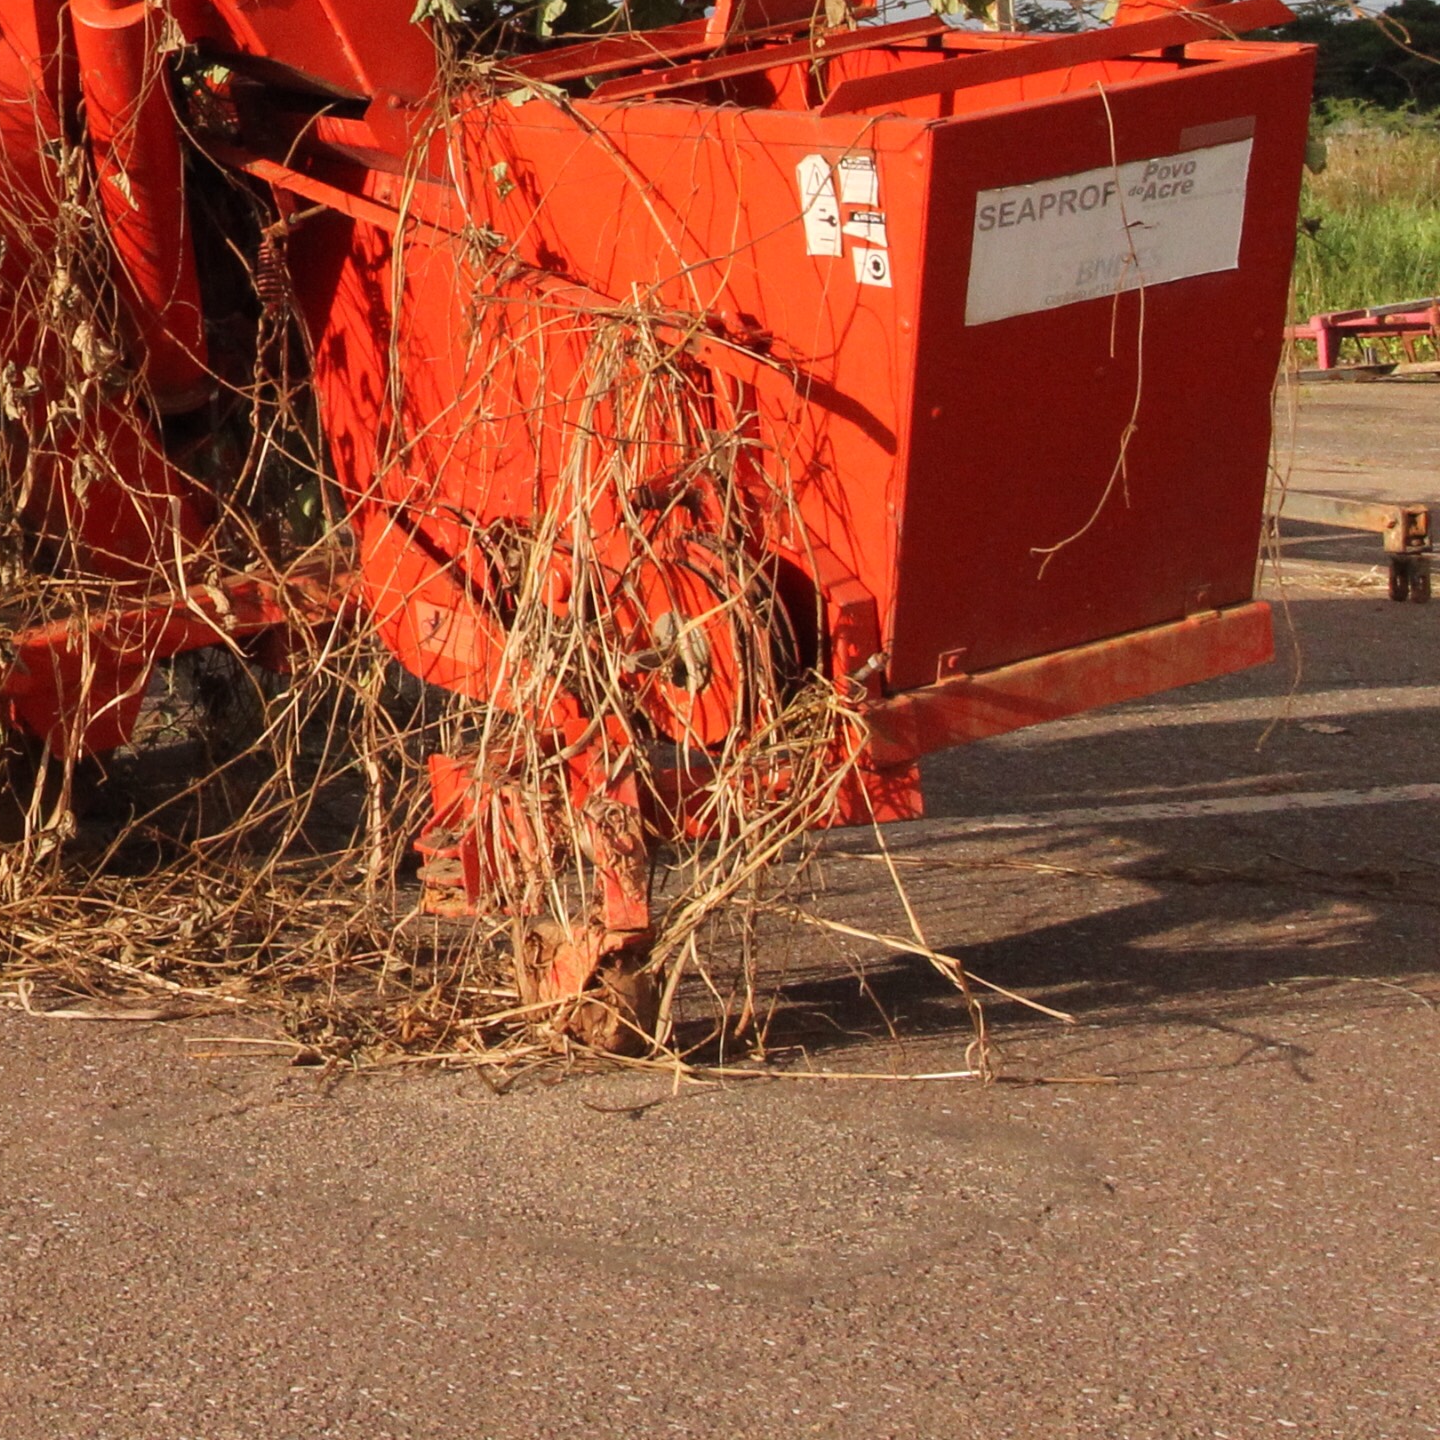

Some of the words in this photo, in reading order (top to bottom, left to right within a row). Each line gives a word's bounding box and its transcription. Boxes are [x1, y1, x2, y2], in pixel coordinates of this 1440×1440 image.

[1141, 160, 1197, 182] Povo
[1142, 178, 1194, 201] Acre
[977, 180, 1117, 232] SEAPROF
